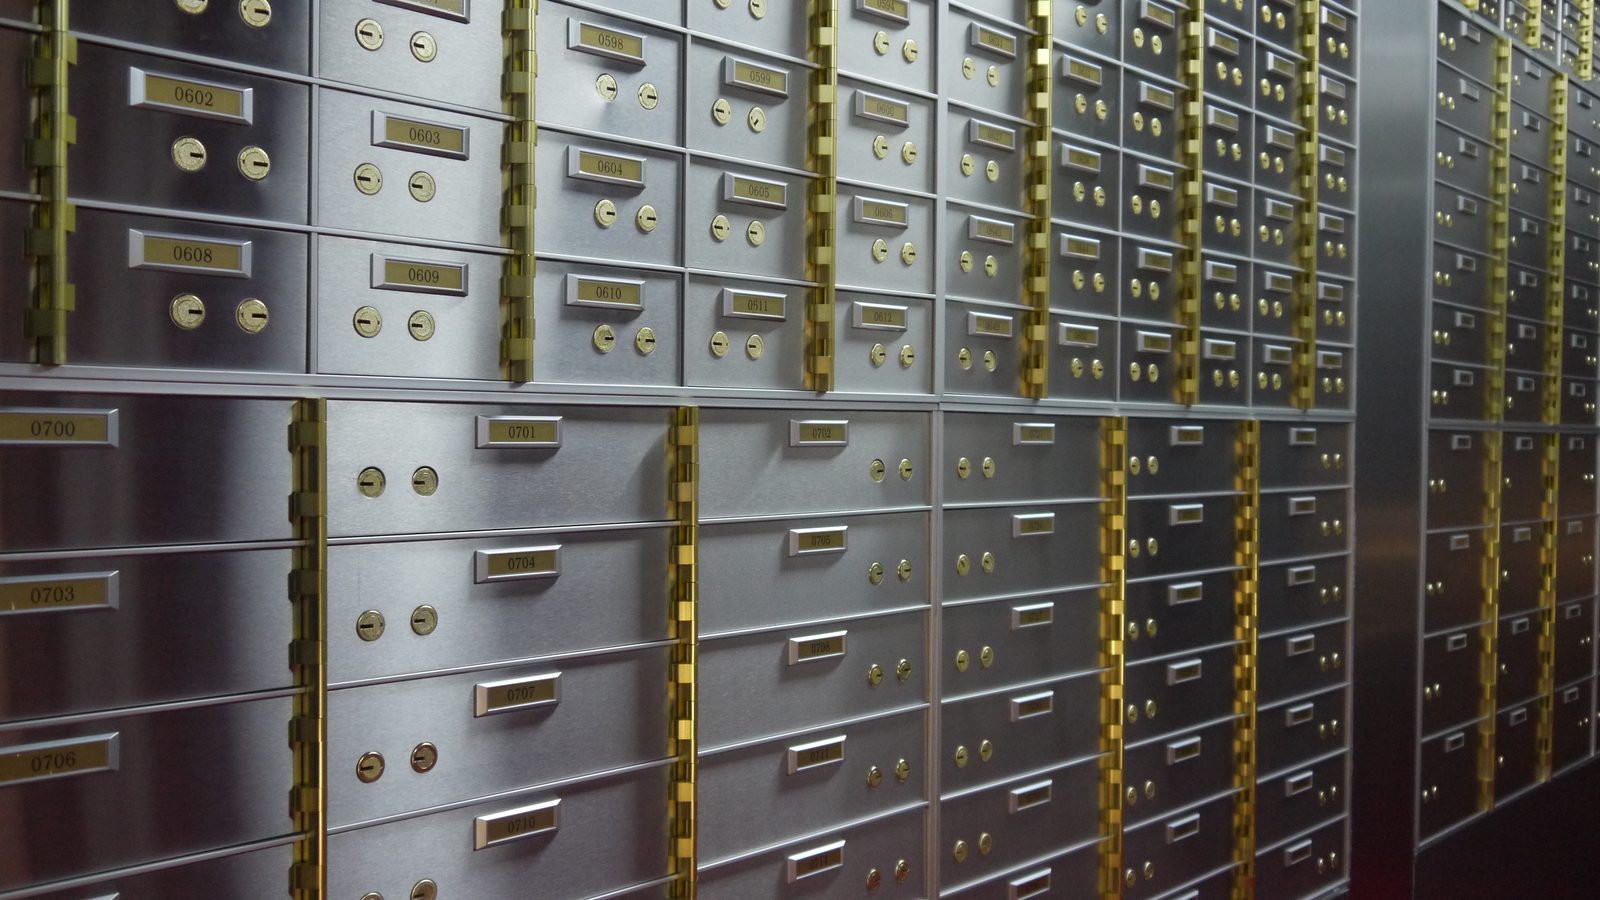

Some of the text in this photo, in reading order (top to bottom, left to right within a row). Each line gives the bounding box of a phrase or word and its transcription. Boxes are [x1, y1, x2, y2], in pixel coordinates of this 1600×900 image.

[597, 34, 625, 50] 0598
[750, 70, 772, 86] 0599
[174, 86, 214, 106] 0602
[409, 127, 441, 146] 0603
[597, 160, 624, 175] 0604
[748, 184, 770, 199] 0605
[172, 245, 213, 264] 0608
[408, 266, 440, 284] 0609
[595, 285, 623, 300] 0610
[747, 299, 769, 312] 0611
[874, 311, 892, 323] 0612
[30, 420, 76, 438] 0700
[508, 424, 537, 440] 0701
[812, 427, 832, 439] 0702
[812, 535, 832, 546] 0705
[508, 555, 536, 571] 0704
[30, 586, 75, 604] 0703
[507, 684, 536, 701] 0707
[30, 751, 76, 771] 0706
[507, 815, 537, 832] 0710
